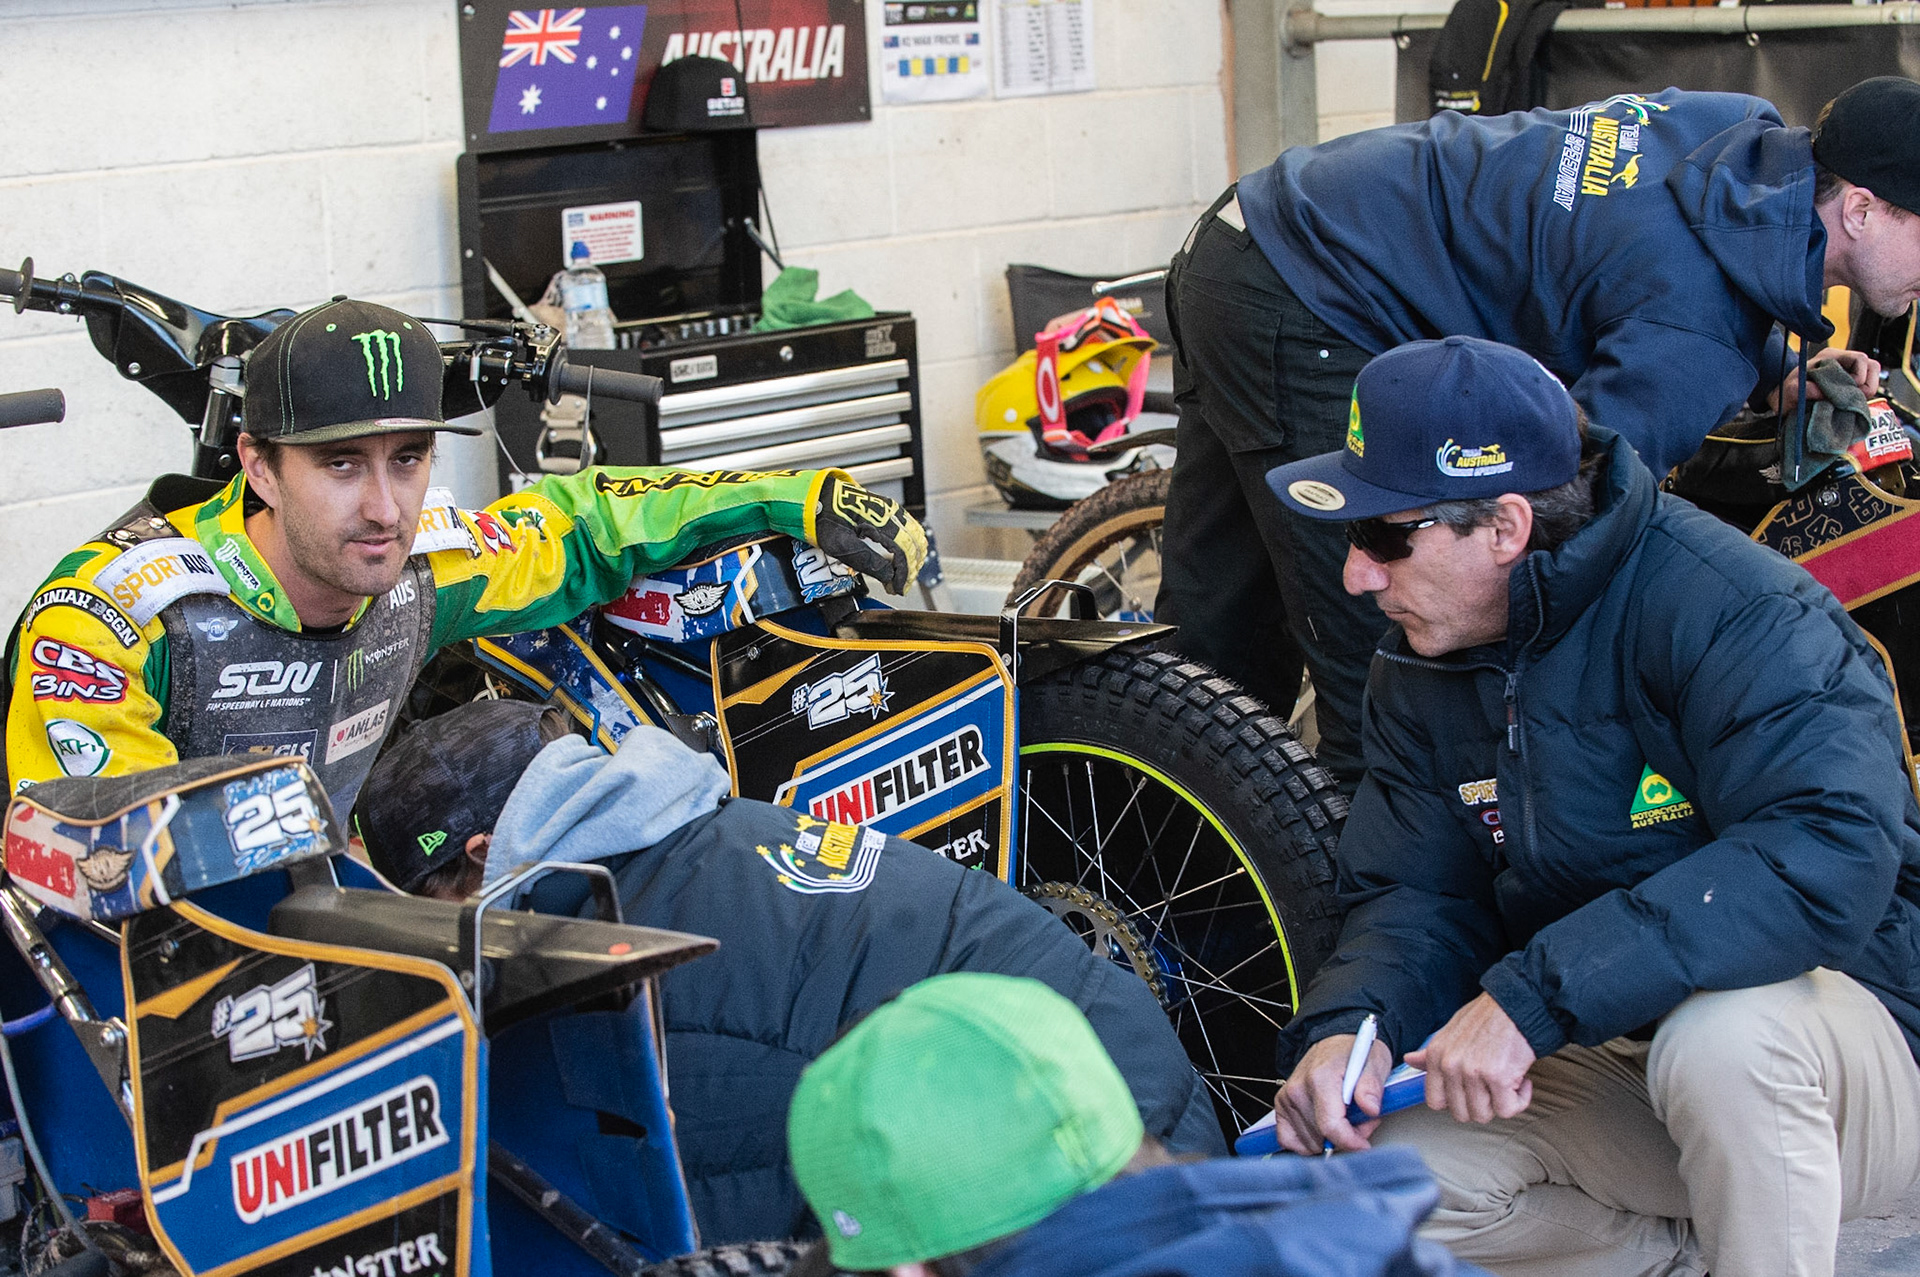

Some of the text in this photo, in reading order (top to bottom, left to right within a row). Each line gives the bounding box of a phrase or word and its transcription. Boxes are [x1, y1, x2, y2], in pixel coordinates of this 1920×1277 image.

[1581, 115, 1620, 196] AUSTRALIA
[1619, 123, 1640, 152] TEAM
[1553, 132, 1586, 212] SPEEDWAY
[1456, 452, 1506, 468] AUSTRALIA
[232, 555, 260, 589] MONSTER
[389, 579, 416, 610] AUS
[33, 639, 125, 690] CBS
[365, 637, 410, 665] MONSTER
[32, 674, 122, 700] BINS
[791, 652, 885, 730] #25
[346, 709, 386, 741] ANLAS
[813, 728, 985, 826] UNIFILTER
[224, 779, 325, 853] 25
[1632, 808, 1695, 829] AUSTRALIA
[211, 962, 332, 1062] #25
[235, 1084, 441, 1214] UNIFILTER
